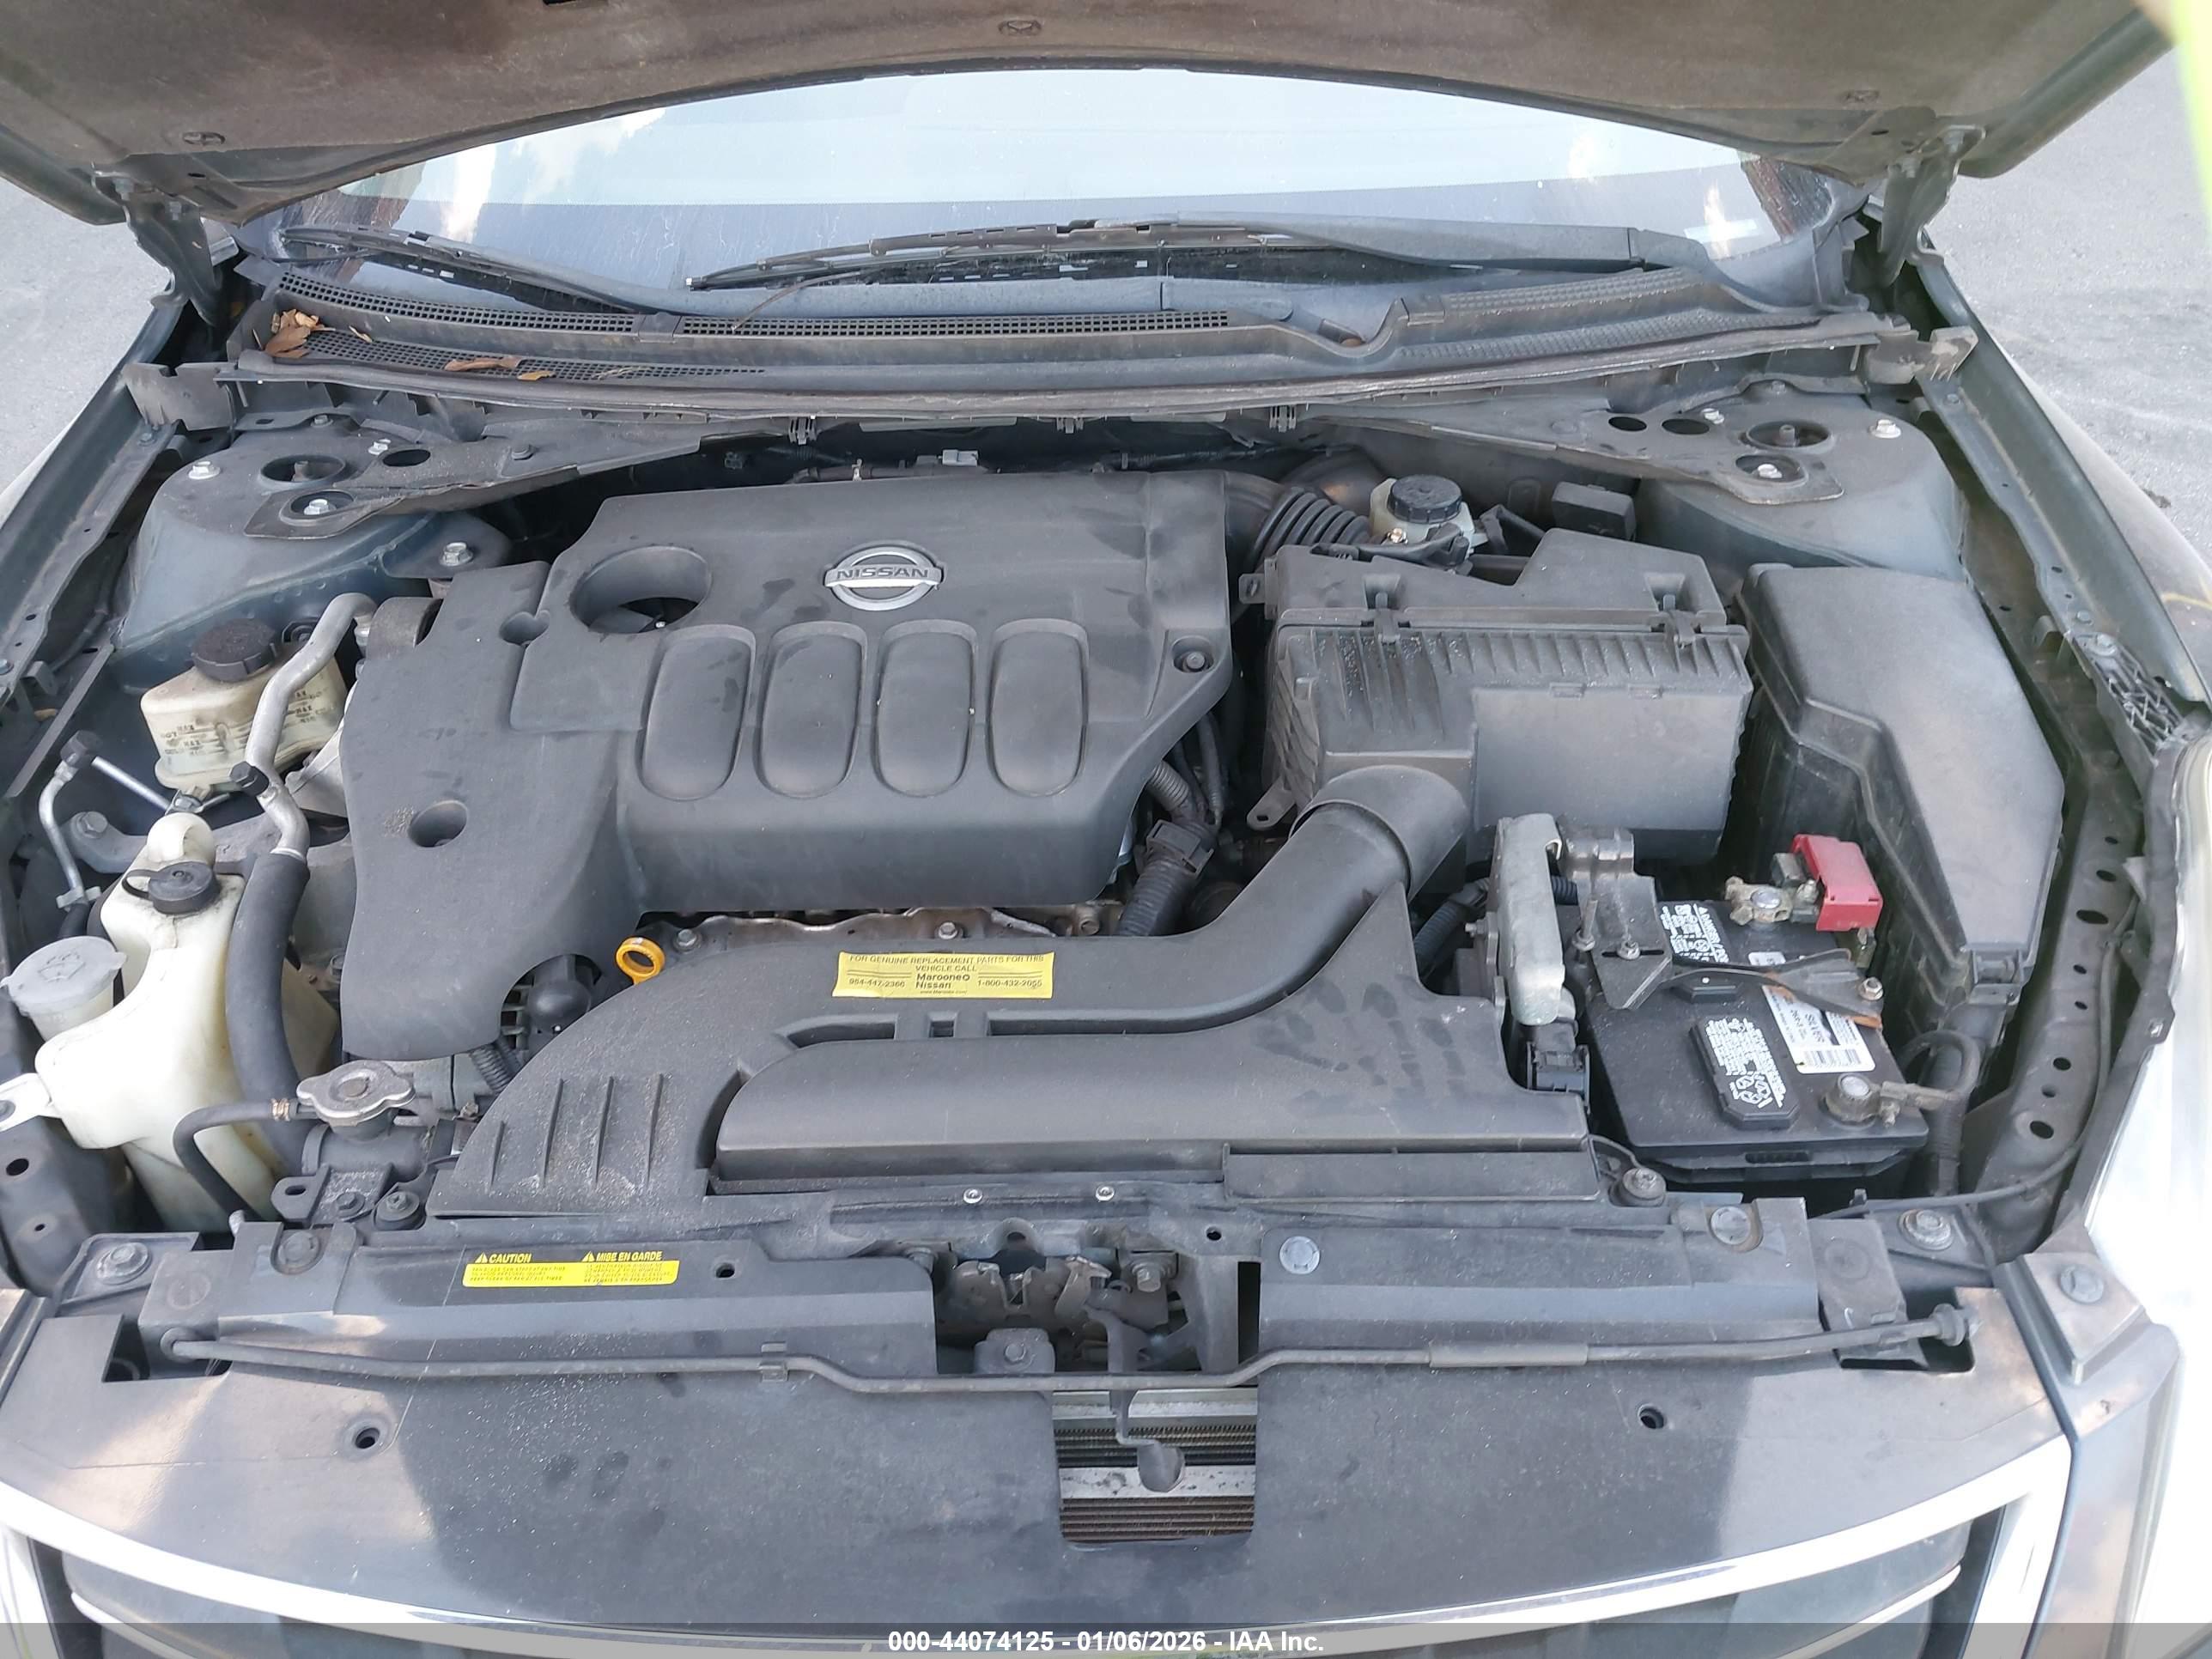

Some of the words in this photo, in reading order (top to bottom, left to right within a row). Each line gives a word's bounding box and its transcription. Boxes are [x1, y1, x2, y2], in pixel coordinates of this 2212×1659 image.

[836, 567, 928, 579] NISSAN
[870, 956, 908, 964] GENUINE
[910, 956, 975, 965] REPLACEMENT
[977, 956, 1004, 964] PARTS
[1026, 954, 1044, 963] THIS
[915, 981, 951, 989] Nissan
[489, 1253, 532, 1263] CAUTION
[596, 1252, 617, 1262] MISE
[617, 1251, 631, 1261] EN
[631, 1250, 663, 1261] GARDE
